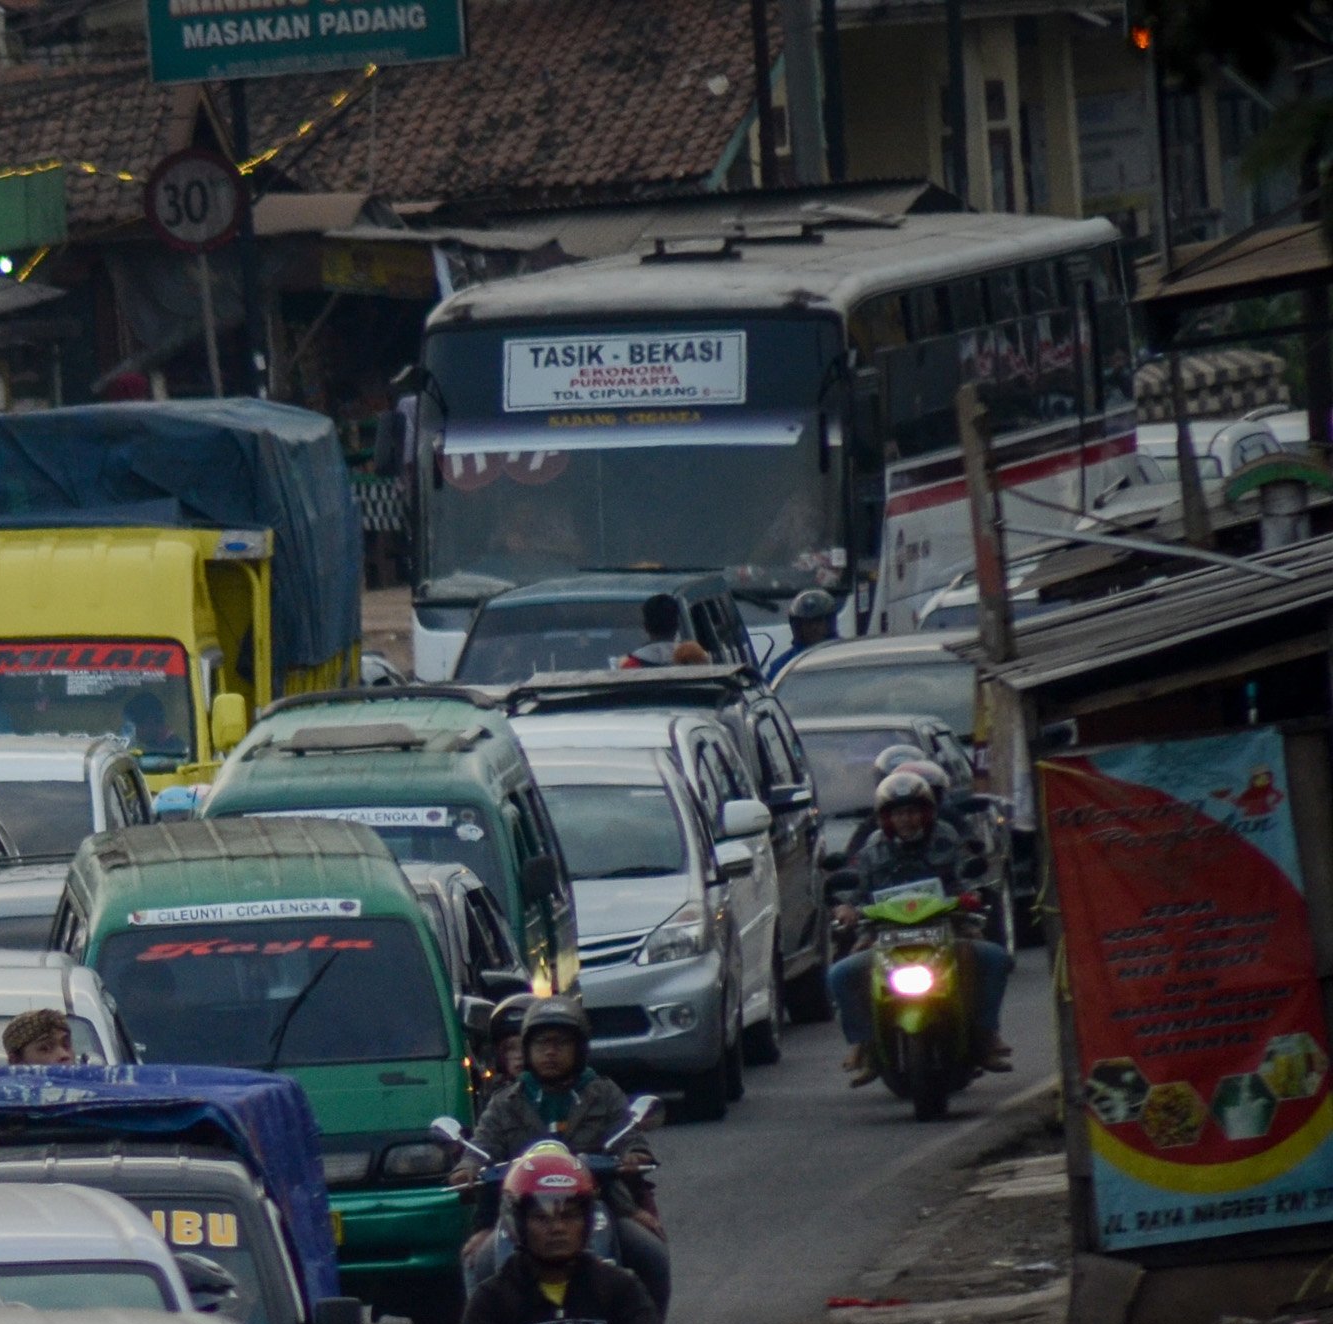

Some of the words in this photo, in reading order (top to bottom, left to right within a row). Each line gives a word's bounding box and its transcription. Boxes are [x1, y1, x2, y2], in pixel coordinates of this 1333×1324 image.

[183, 15, 311, 49] MASAKAN
[319, 4, 428, 36] PADANG
[164, 180, 209, 228] 30
[529, 345, 605, 369] TASIK
[628, 340, 724, 365] BEKASI
[570, 376, 680, 389] PURWAKARTA
[579, 366, 673, 379] EKONOMI
[552, 389, 583, 402] TOL
[589, 386, 699, 400] CIPULARANG
[157, 907, 223, 923] CILEUNYI
[235, 900, 332, 918] CICALENGKA
